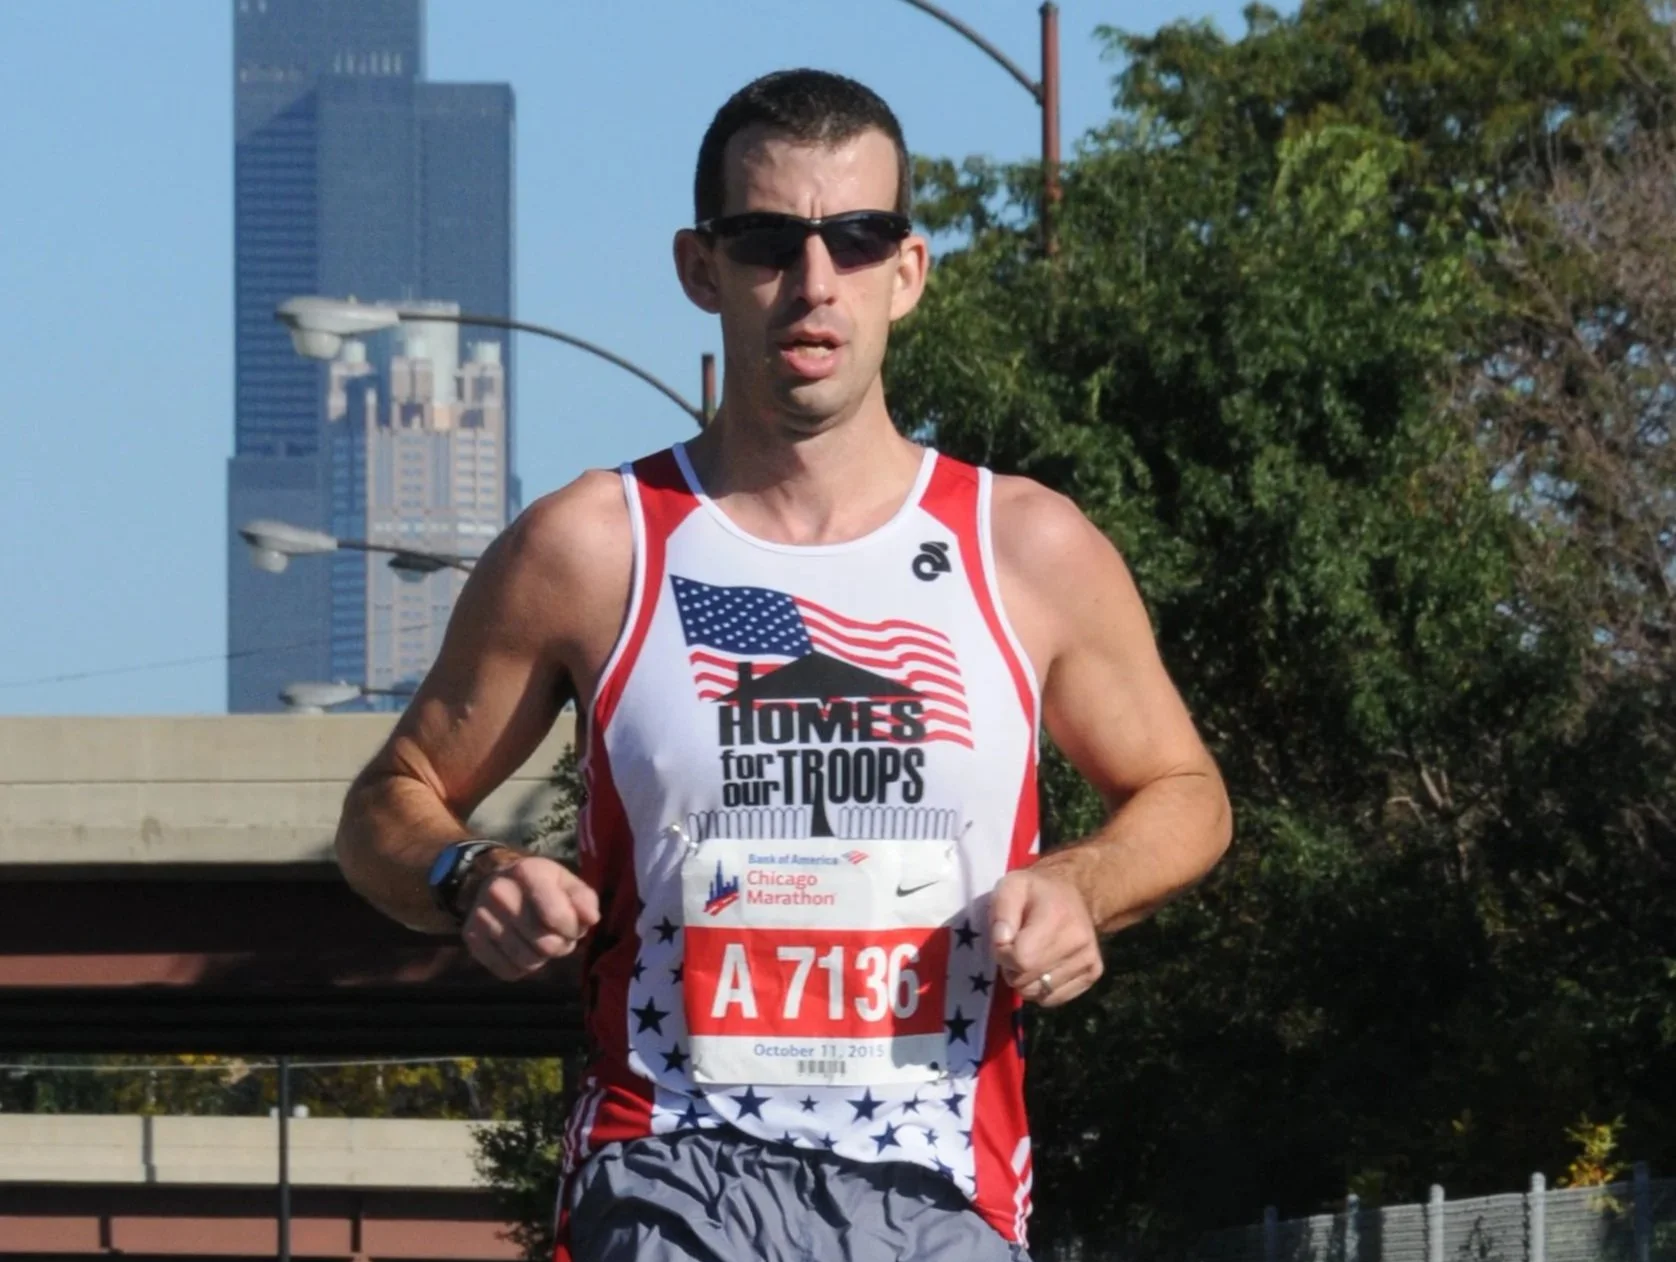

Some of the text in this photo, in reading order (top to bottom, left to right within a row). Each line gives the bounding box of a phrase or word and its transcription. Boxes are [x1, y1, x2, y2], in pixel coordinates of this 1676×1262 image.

[718, 700, 926, 746] HOMES
[720, 749, 774, 780] for
[777, 747, 925, 808] TROOPS
[722, 780, 780, 807] our
[748, 853, 838, 866] Bank of America
[747, 869, 818, 889] Chicago
[747, 889, 835, 905] Marathon
[710, 943, 920, 1022] A 7136
[753, 1043, 885, 1058] October 11, 2015
